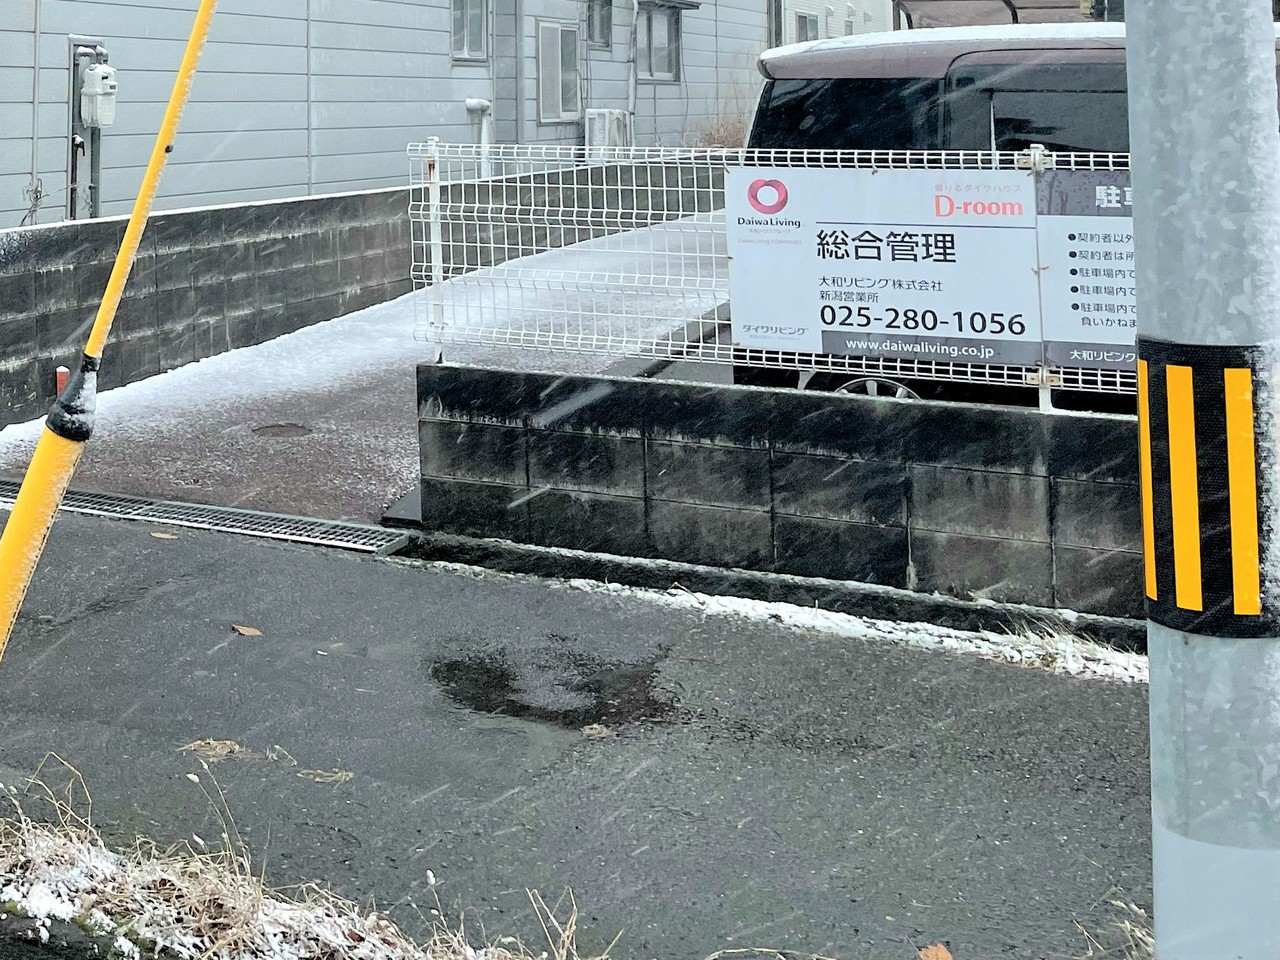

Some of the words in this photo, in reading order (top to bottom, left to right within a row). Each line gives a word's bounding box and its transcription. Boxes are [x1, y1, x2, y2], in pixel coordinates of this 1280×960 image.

[934, 194, 1023, 218] D-room
[816, 229, 957, 263] 総合管理
[818, 275, 944, 292] 大和リビング株式会社
[819, 290, 879, 303] 新潟営業所
[742, 324, 809, 335] ダイワリビング
[820, 304, 1026, 335] 025-280-1056
[845, 339, 994, 359] www.daiwaliving.co.jp
